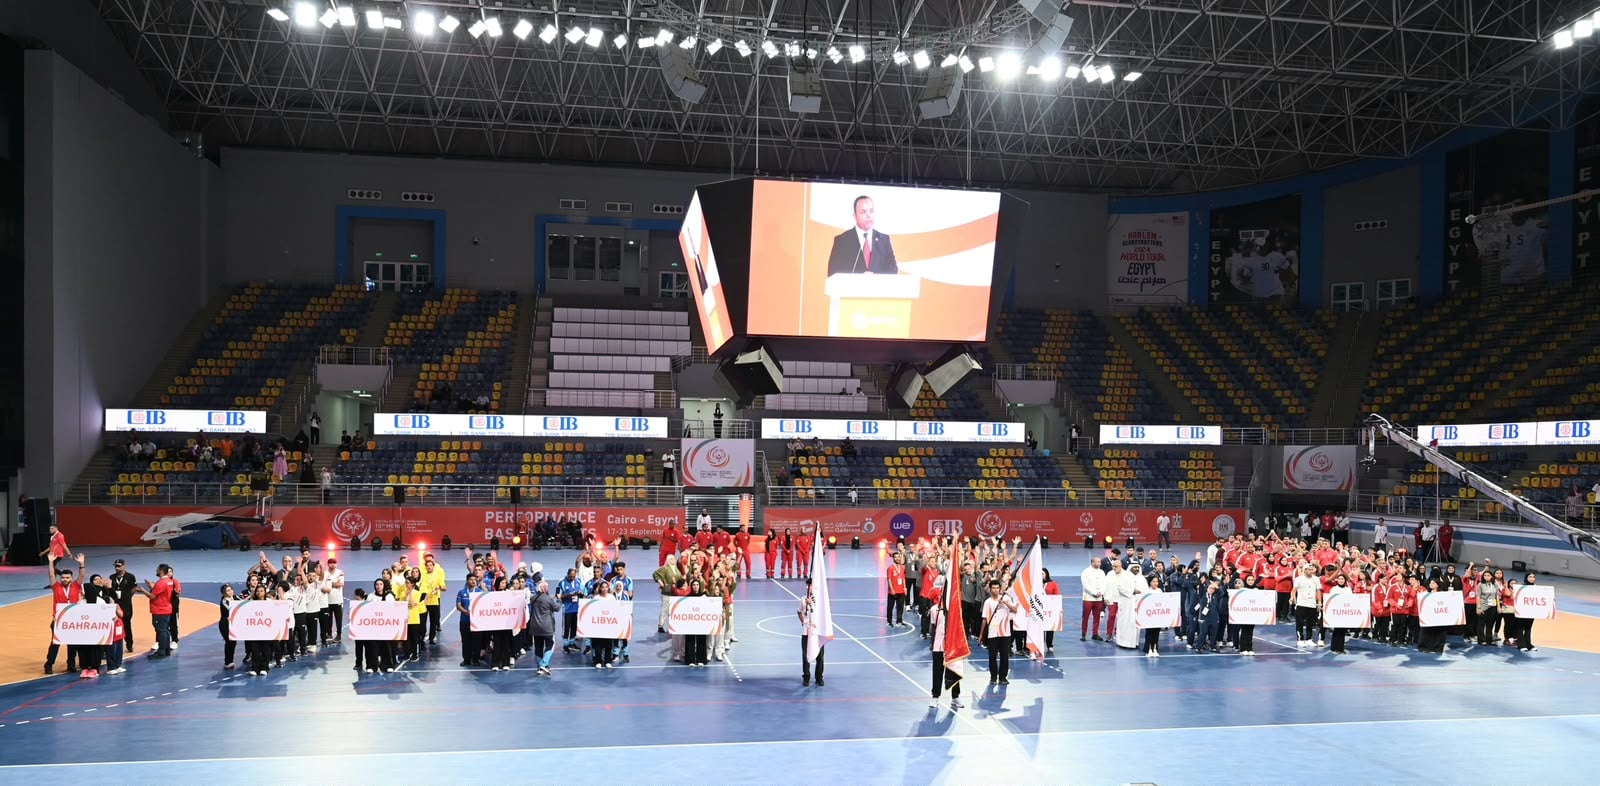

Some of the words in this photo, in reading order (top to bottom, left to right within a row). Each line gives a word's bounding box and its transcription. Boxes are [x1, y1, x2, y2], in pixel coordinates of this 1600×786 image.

[1448, 208, 1462, 290] EGYPT
[1128, 263, 1156, 275] EGYPT
[1210, 240, 1222, 303] EGYPT
[607, 514, 637, 524] Cairo
[607, 527, 628, 536] 17-23
[1523, 596, 1546, 606] RYLS
[479, 607, 518, 617] KUWAIT
[1145, 607, 1171, 616] QATAR
[591, 616, 618, 625] LIBYA
[673, 613, 718, 621] MOROCCO
[62, 621, 109, 630] BAHRAIN
[246, 618, 272, 627] IRAQ
[357, 618, 399, 626] JORDAN
